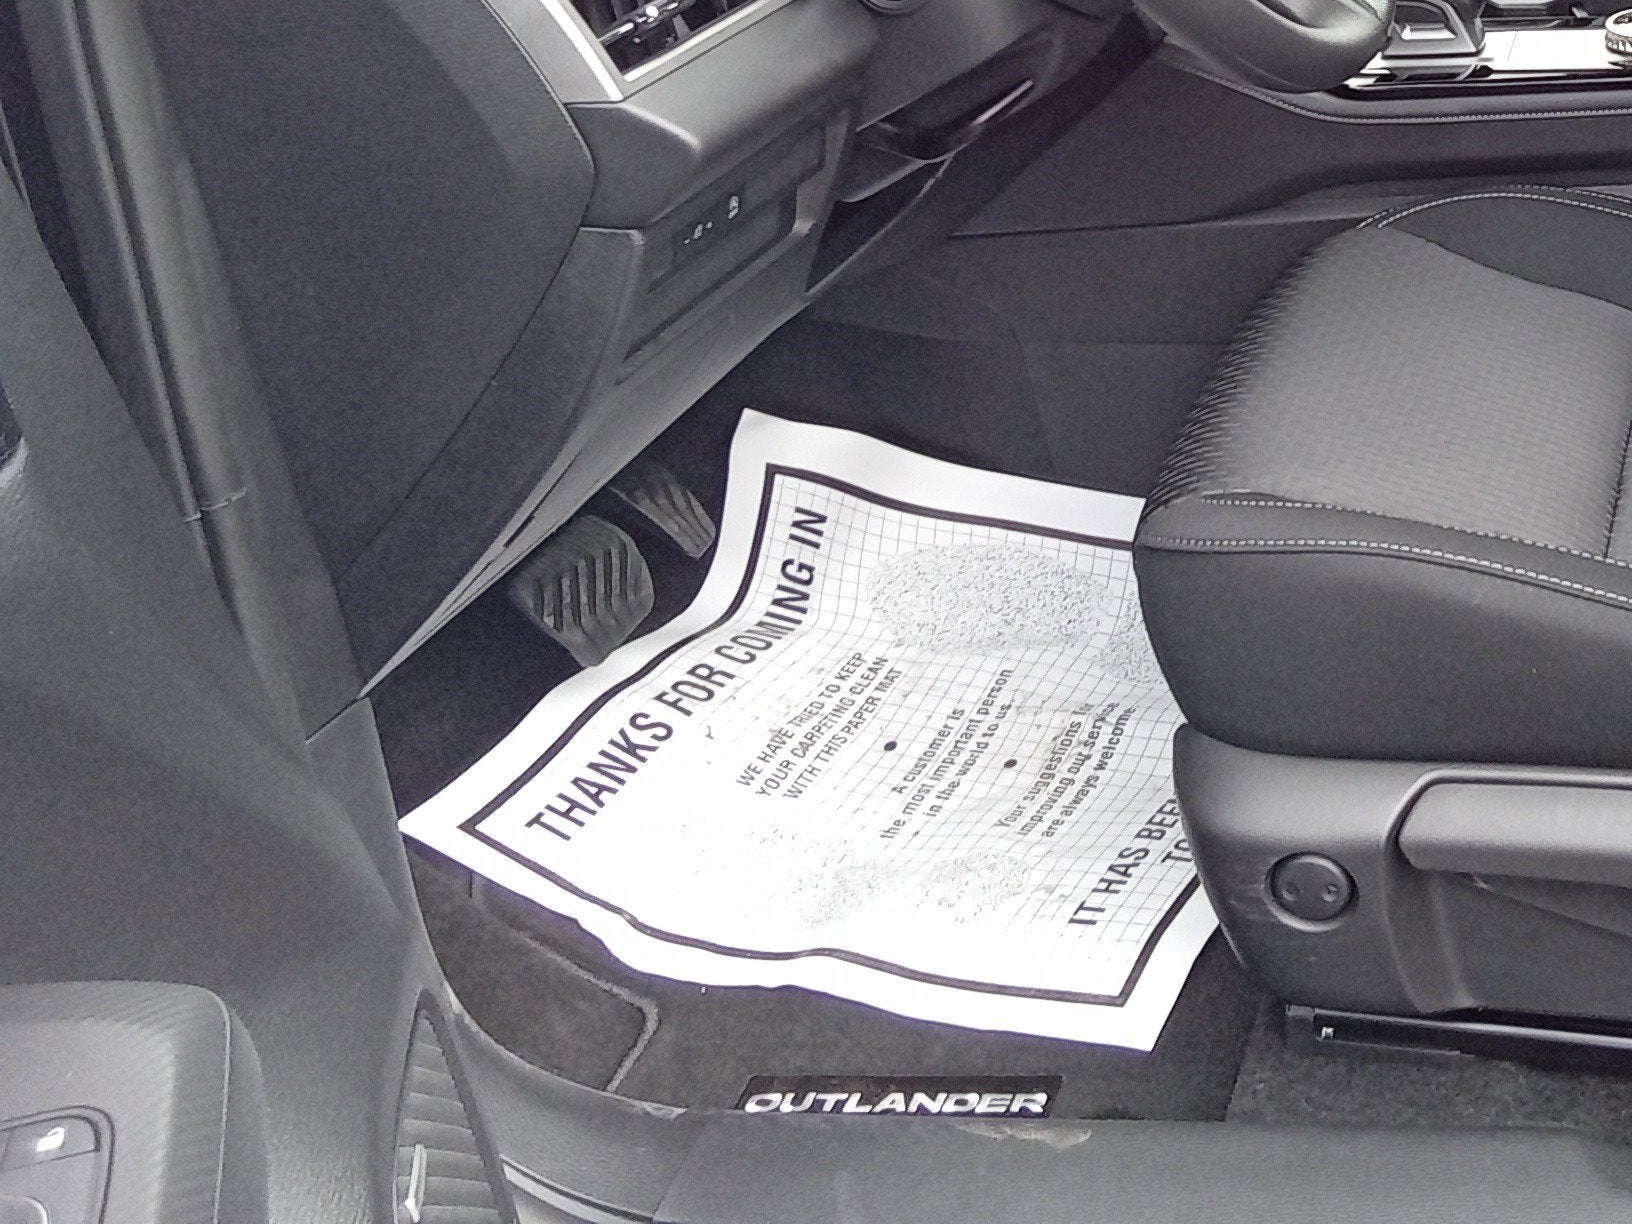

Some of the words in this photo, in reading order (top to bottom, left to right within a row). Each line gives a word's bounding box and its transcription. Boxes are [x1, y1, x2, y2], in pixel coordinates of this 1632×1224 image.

[524, 712, 674, 841] THANKS
[653, 663, 736, 717] FOR
[714, 558, 816, 664] COMING
[789, 507, 828, 549] IN
[736, 763, 763, 786] WE
[757, 728, 795, 763] HAVE
[787, 700, 825, 727] TRIED
[818, 684, 841, 698] TO
[834, 652, 867, 681] KEEP
[755, 760, 797, 797] YOUR
[791, 697, 855, 758] CARPETING
[849, 656, 889, 695] CLEAN
[783, 764, 822, 799] WITH
[814, 734, 848, 762] THIS
[841, 696, 882, 735] PAPER
[874, 667, 903, 693] MAT
[880, 819, 906, 838] the
[902, 784, 934, 815] most
[930, 719, 982, 781] important
[976, 669, 1014, 716] person
[891, 785, 908, 794] A
[903, 724, 953, 782] customer
[922, 804, 943, 817] in
[935, 780, 960, 800] the
[955, 741, 989, 777] world
[982, 725, 999, 738] to
[992, 804, 1027, 827] Your
[1023, 720, 1082, 801] suggestions
[1017, 776, 1075, 836] improving
[1067, 752, 1093, 775] our
[1041, 819, 1065, 837] are
[1060, 775, 1100, 817] always
[1093, 707, 1137, 771] welcome
[1068, 901, 1106, 925] IT
[1092, 847, 1150, 894] HAS
[744, 1091, 1049, 1114] OUTLANDER
